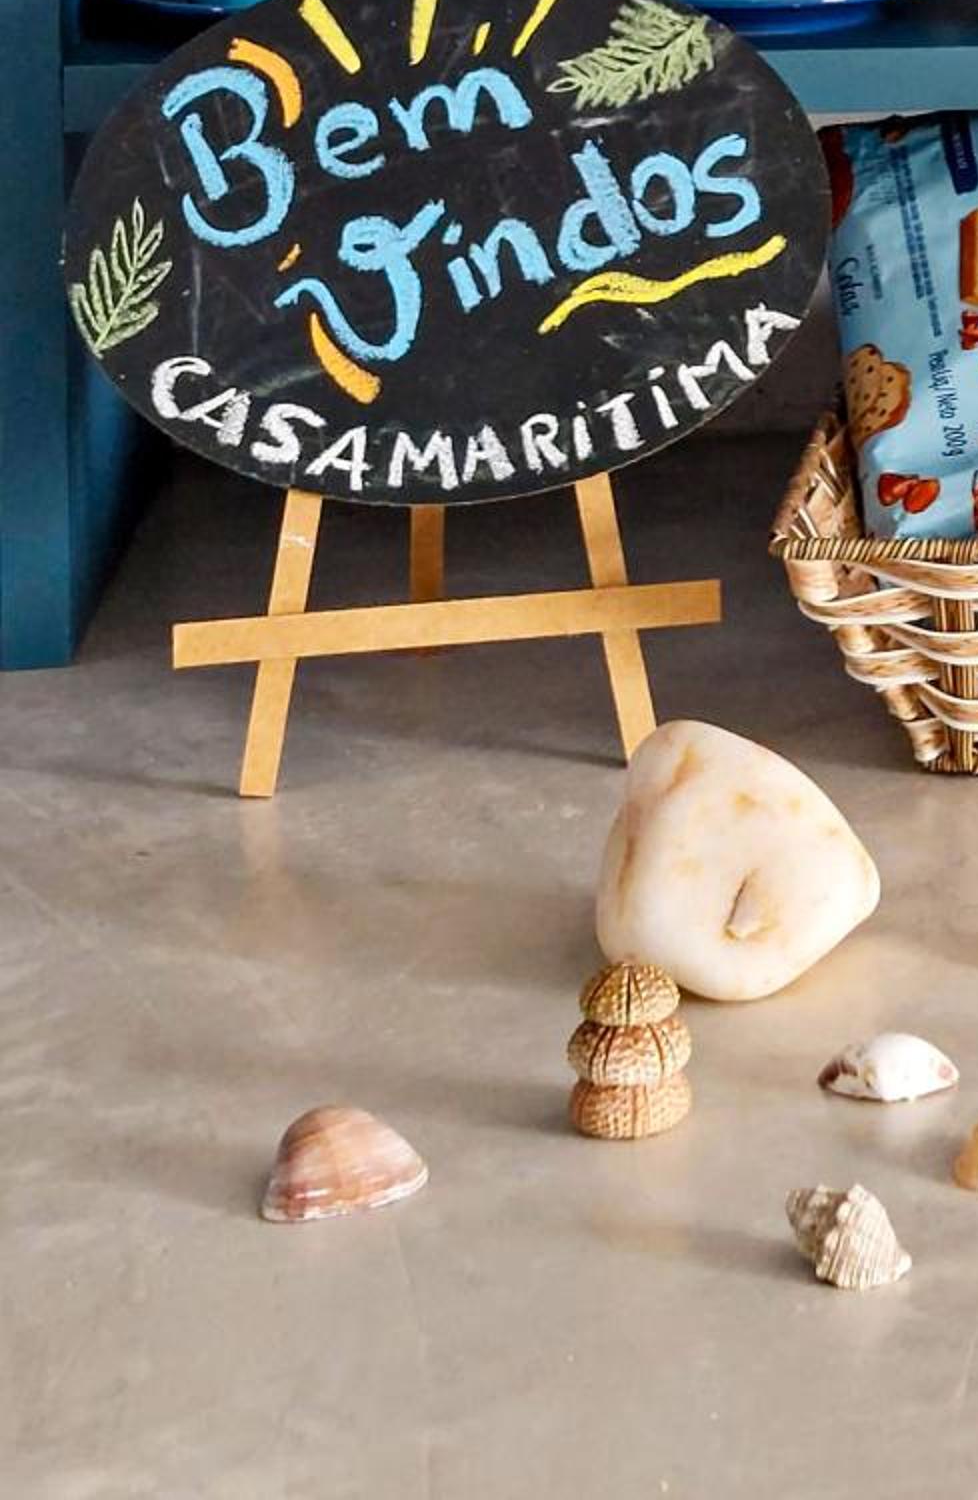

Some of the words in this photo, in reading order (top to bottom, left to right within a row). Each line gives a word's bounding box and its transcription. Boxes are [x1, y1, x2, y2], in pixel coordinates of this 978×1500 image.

[160, 66, 534, 247] Bem
[275, 133, 763, 362] Vindos
[941, 423, 968, 457] 200g
